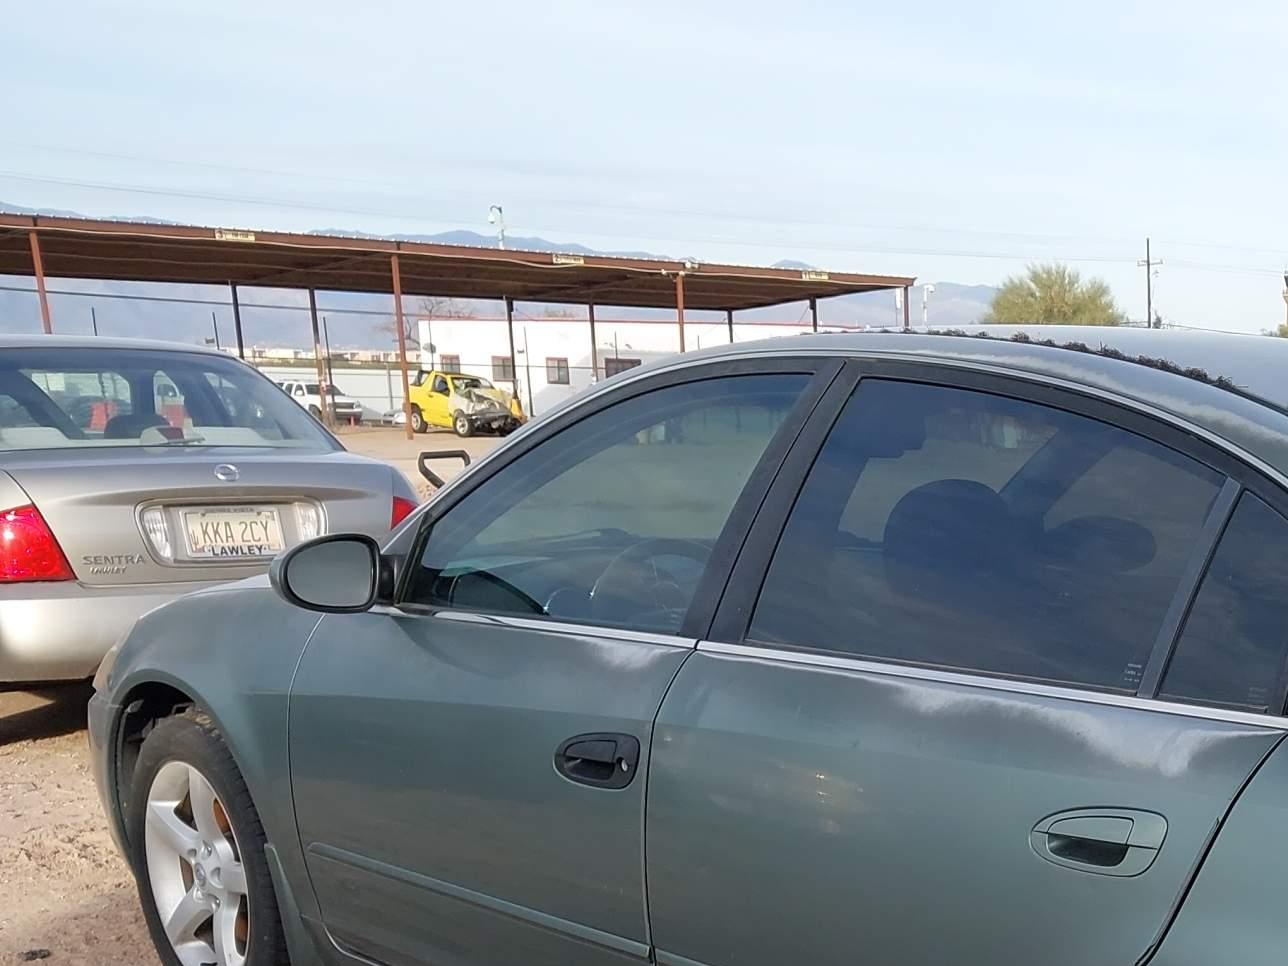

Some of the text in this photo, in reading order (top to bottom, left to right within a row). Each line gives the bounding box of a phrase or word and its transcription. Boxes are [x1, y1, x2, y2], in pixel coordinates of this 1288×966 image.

[200, 519, 270, 544] KKA 2CY
[211, 544, 263, 556] LAWLEY
[82, 553, 145, 566] SENTRA
